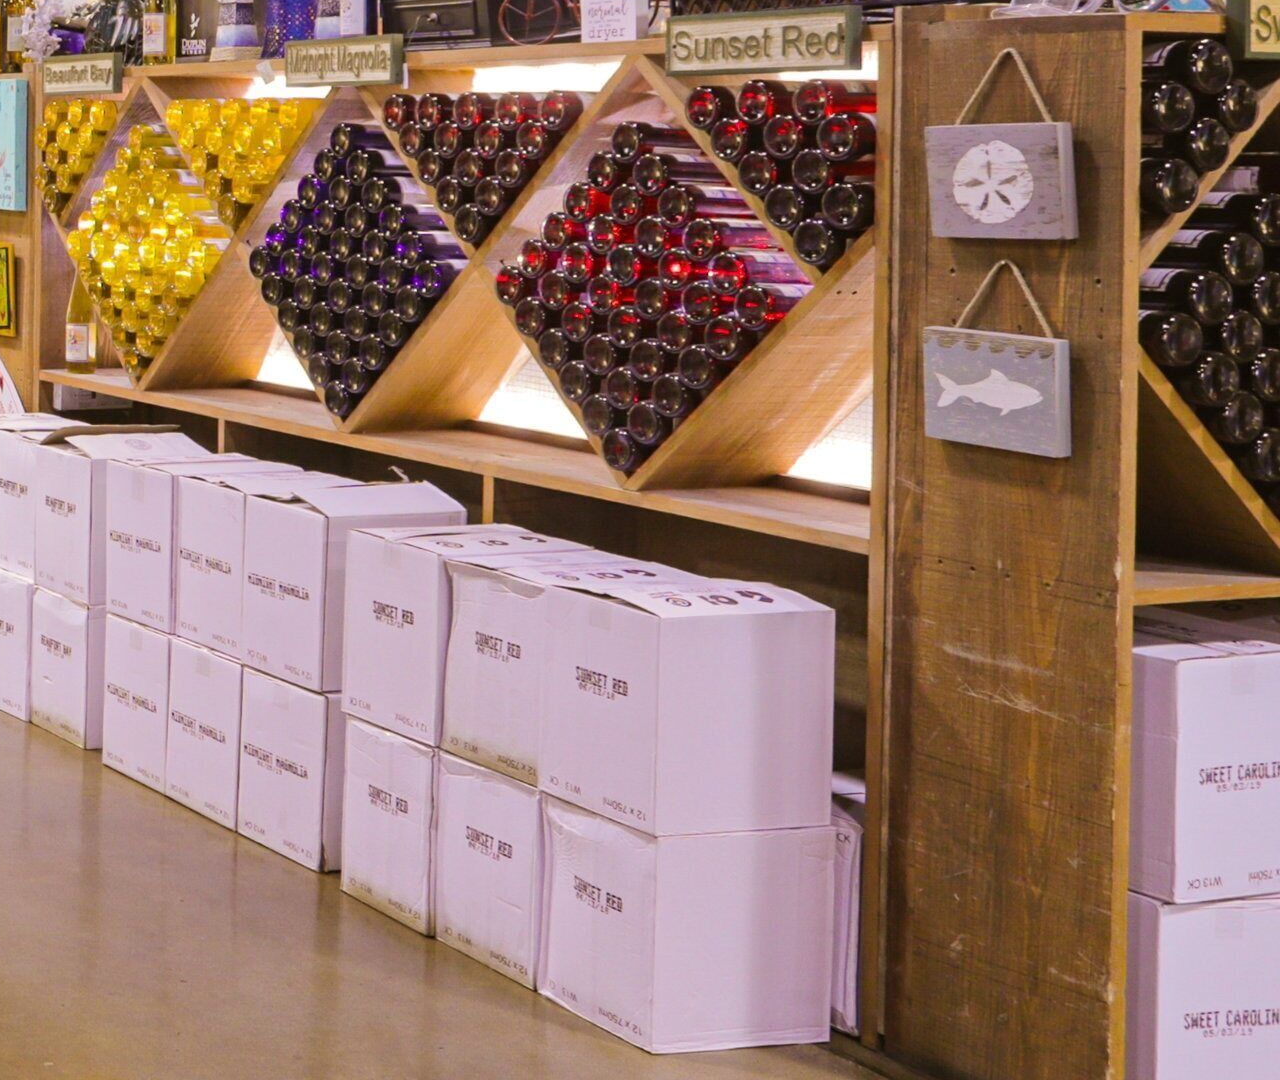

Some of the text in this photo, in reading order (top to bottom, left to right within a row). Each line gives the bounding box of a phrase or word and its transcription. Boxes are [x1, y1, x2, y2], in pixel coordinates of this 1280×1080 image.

[588, 26, 626, 41] dryer
[673, 22, 844, 61] Sunset Red
[90, 64, 111, 86] Bay
[288, 43, 388, 80] Midnight Magnolia
[372, 600, 397, 619] SUNSET
[401, 609, 415, 625] RED
[475, 631, 503, 653] SUNSET
[506, 641, 522, 659] RED
[575, 666, 629, 697] SUNSET RED
[1199, 765, 1232, 786] SWEET
[368, 784, 409, 814] SUNSET RED
[465, 825, 513, 859] SUNSET RED
[574, 875, 624, 913] SUNSET RED
[1183, 1011, 1220, 1030] SWEET
